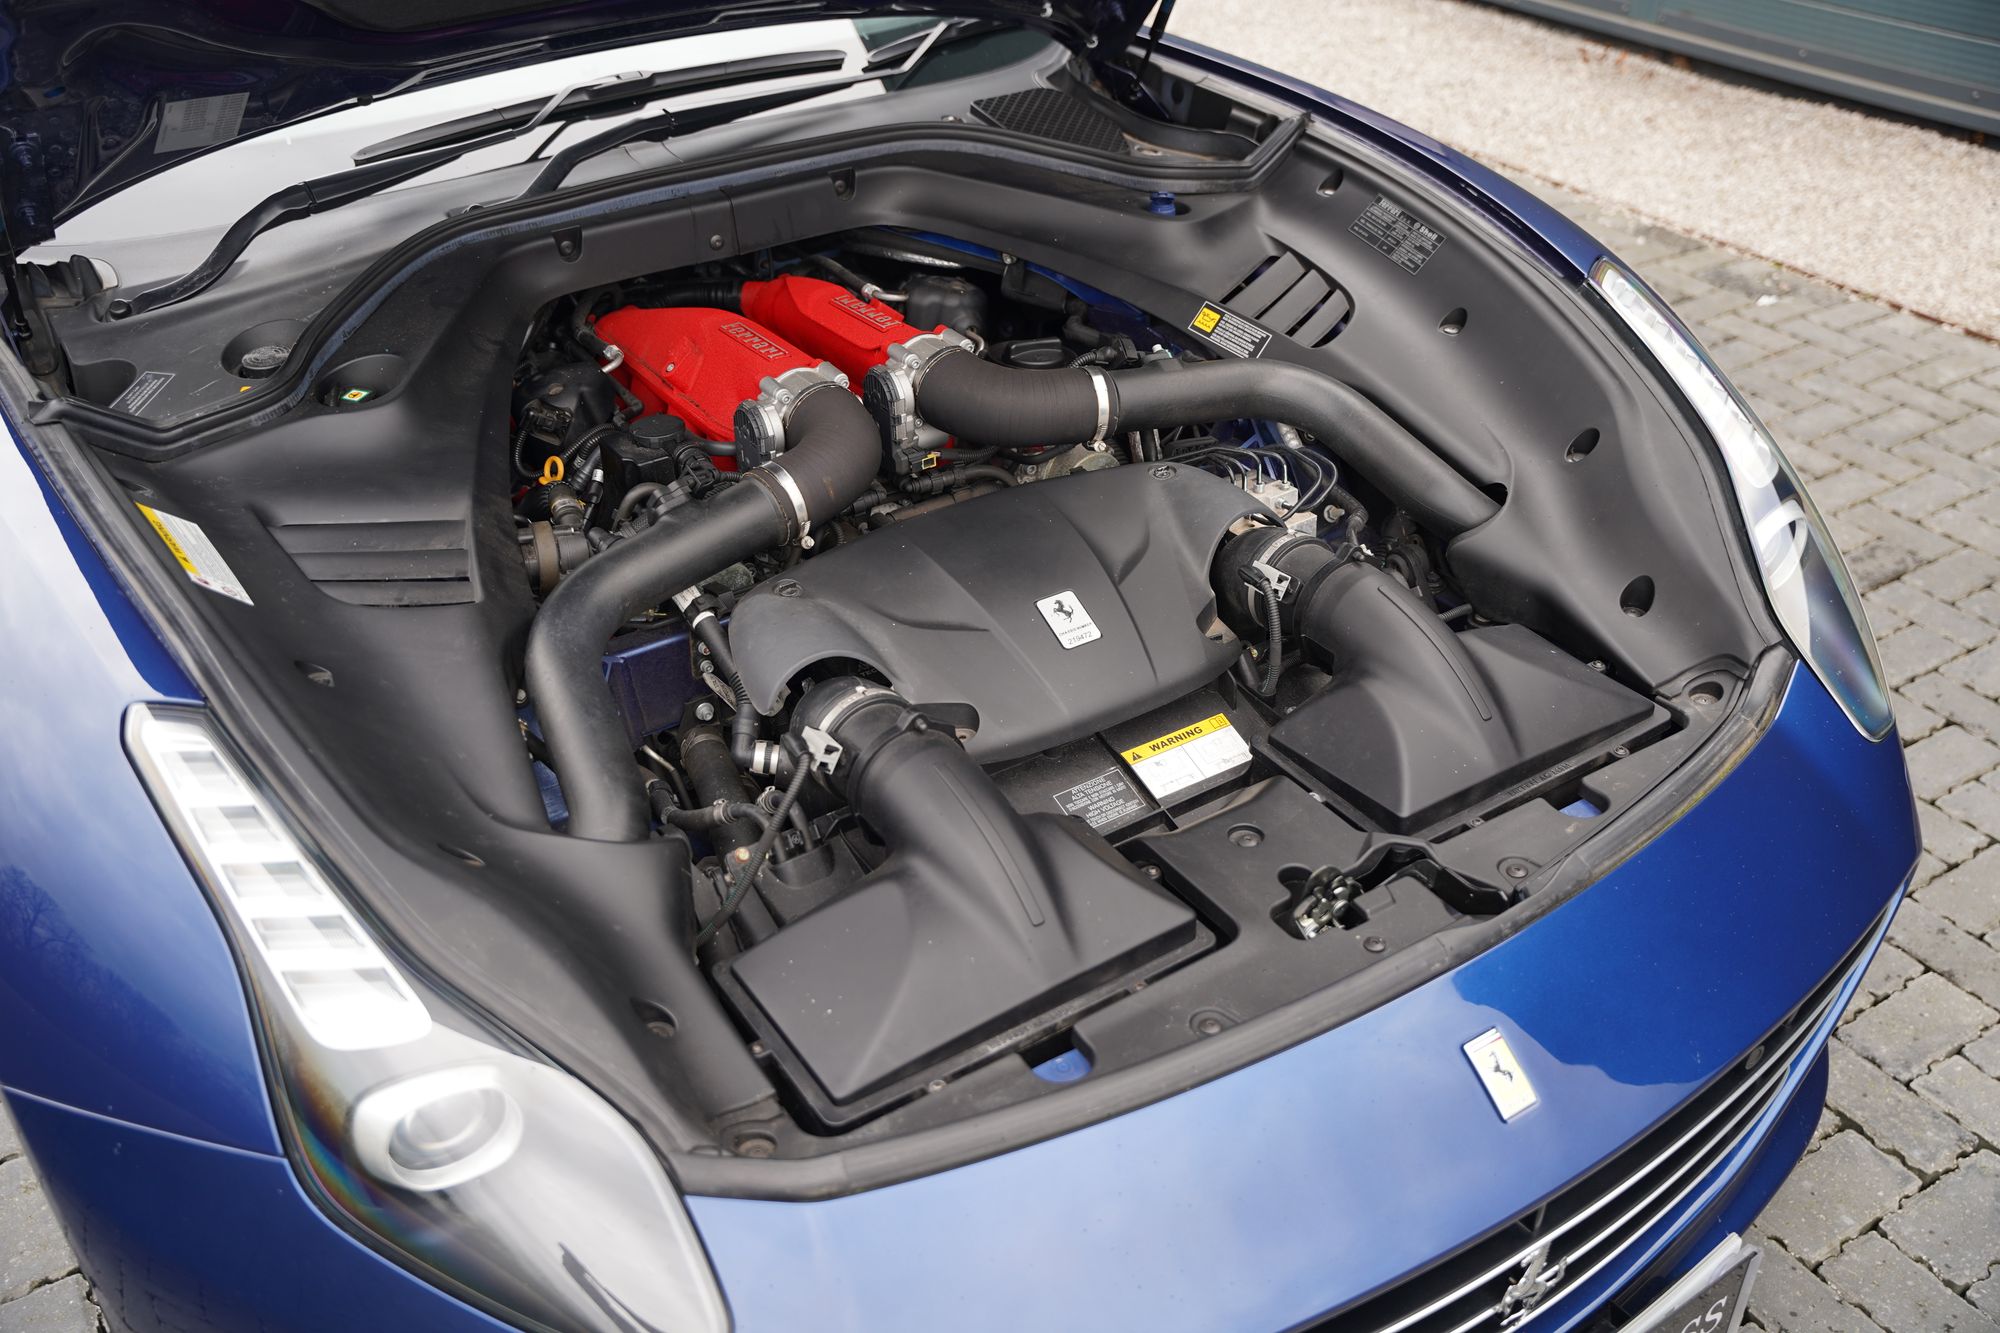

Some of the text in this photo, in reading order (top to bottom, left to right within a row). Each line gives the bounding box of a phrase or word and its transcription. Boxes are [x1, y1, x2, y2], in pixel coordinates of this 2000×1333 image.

[1419, 225, 1438, 241] Shell
[832, 293, 902, 328] Ferrari
[721, 321, 788, 359] Ferrari
[1149, 726, 1203, 752] WARNING
[1071, 776, 1106, 794] ATTENZIONE
[1072, 780, 1113, 800] ALTA TENSIONE
[1085, 809, 1101, 818] HIGH
[1100, 799, 1126, 812] VOLTAGE
[1088, 796, 1115, 810] WARNING
